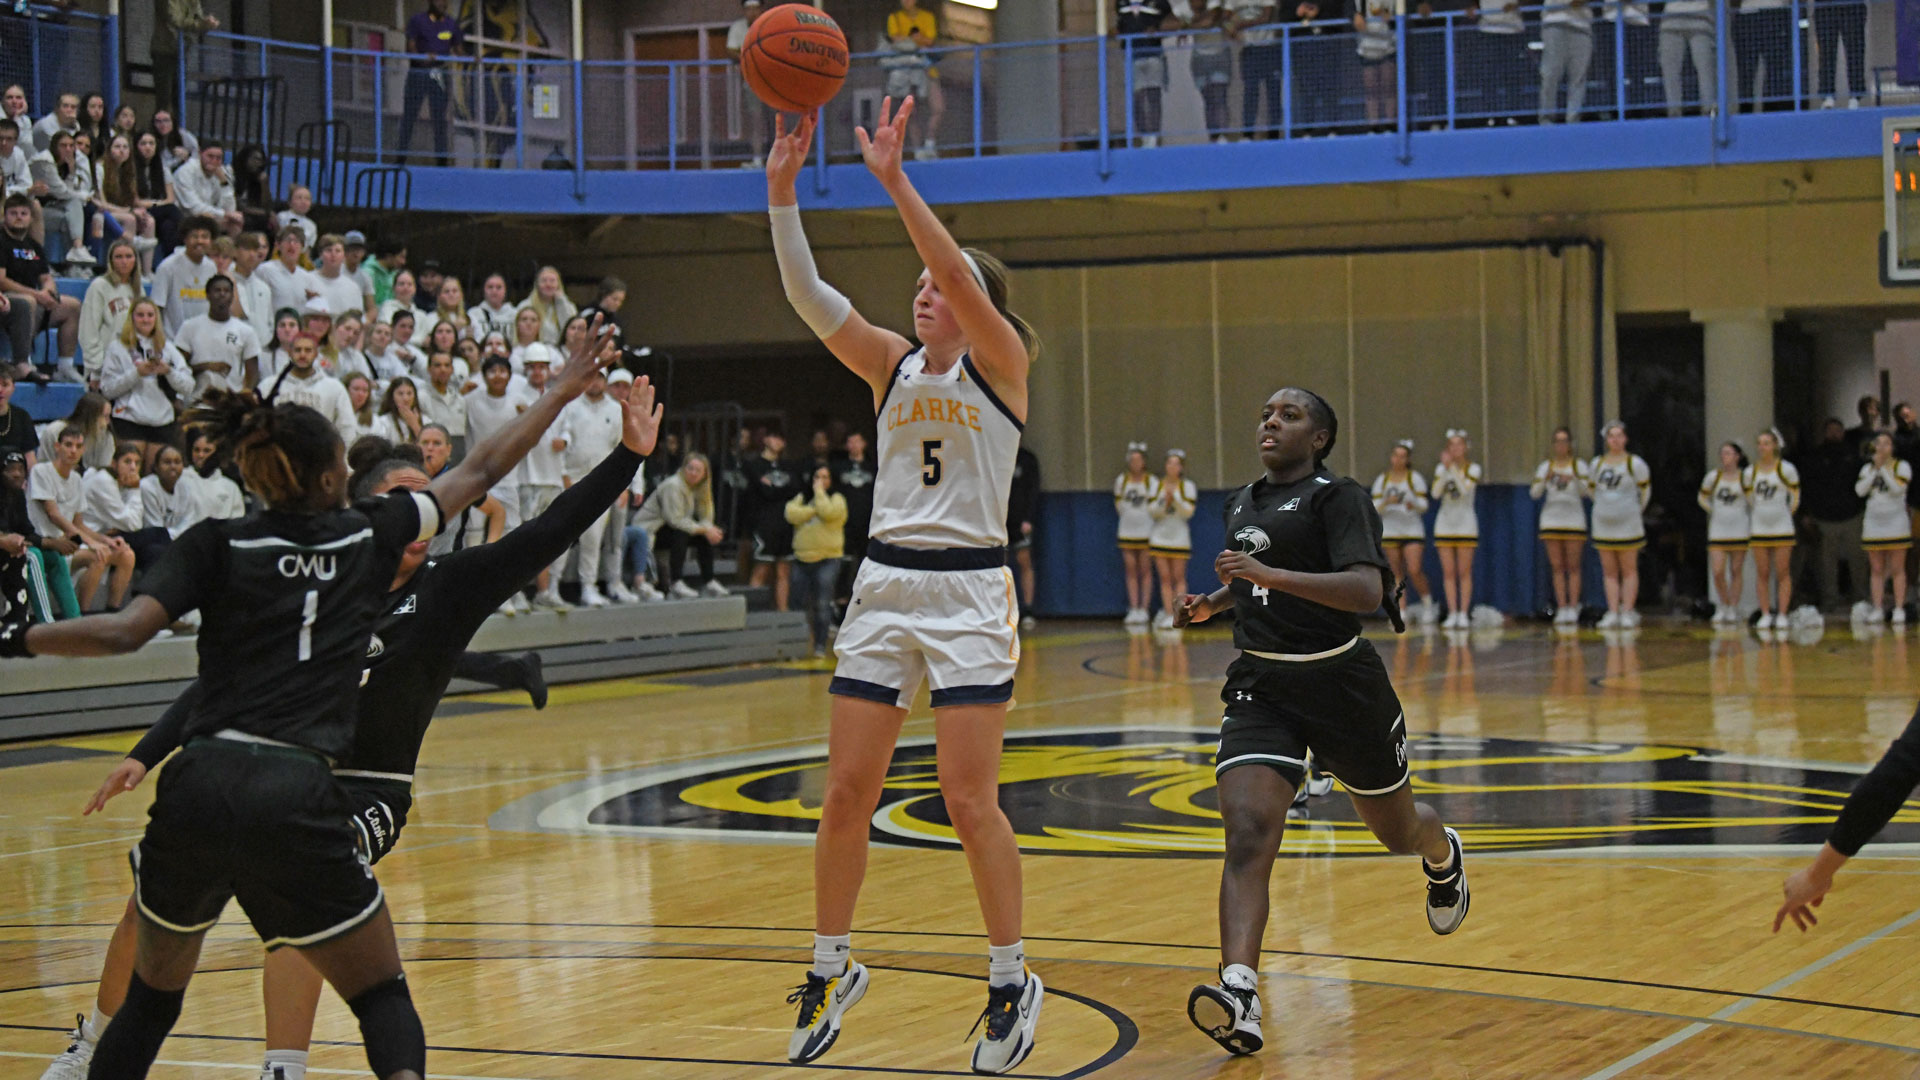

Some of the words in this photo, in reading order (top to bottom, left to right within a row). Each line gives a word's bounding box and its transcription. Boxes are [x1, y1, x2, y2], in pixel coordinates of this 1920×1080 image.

[886, 397, 984, 433] CLARKE
[920, 437, 945, 489] 5
[277, 553, 337, 581] CMU
[1252, 583, 1269, 605] 4
[298, 590, 319, 662] 1
